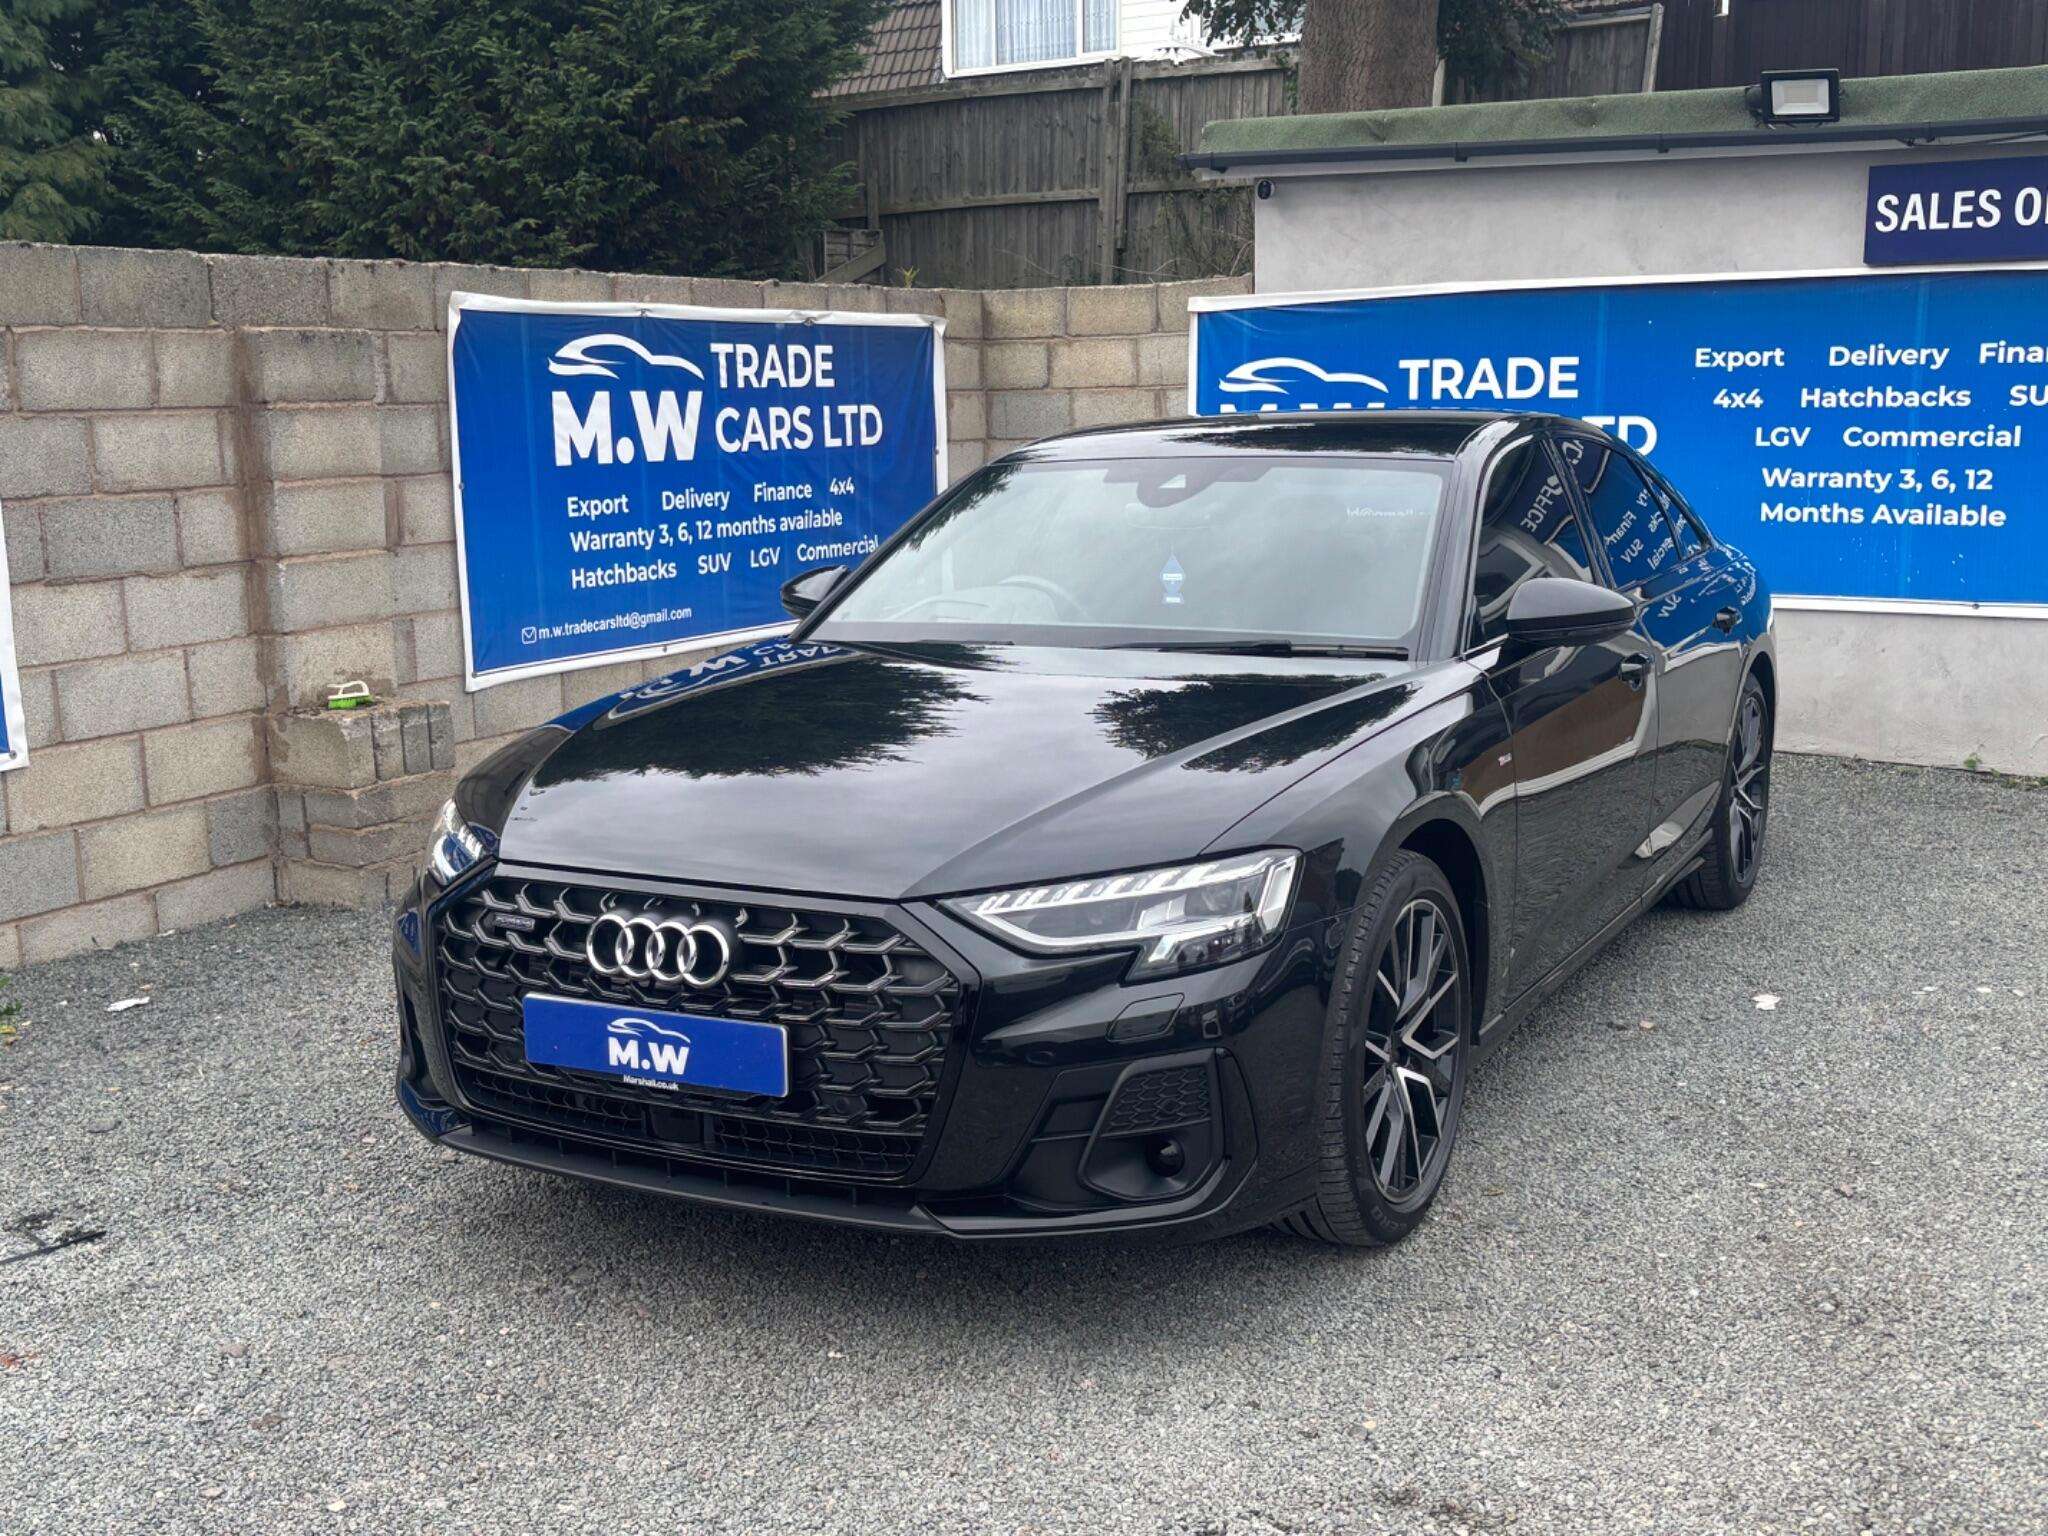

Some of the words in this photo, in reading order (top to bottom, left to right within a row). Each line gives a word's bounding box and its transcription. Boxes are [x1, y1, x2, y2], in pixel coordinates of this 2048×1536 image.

[1875, 188, 2002, 233] SALES
[2014, 187, 2048, 226] O
[710, 342, 835, 388] TRADE
[1695, 347, 1785, 372] Export
[1829, 343, 1950, 370] Delivery
[1979, 340, 2048, 364] Fina
[1398, 356, 1580, 400] TRADE
[1713, 388, 1764, 408] 4x4
[1800, 385, 1971, 408] Hatchbacks
[551, 390, 703, 467] M.W
[715, 405, 814, 453] CARS
[822, 404, 883, 448] LTD
[1755, 426, 1811, 447] LGV
[1842, 424, 2022, 447] Commercial
[567, 494, 629, 521] Export
[661, 487, 730, 511] Delivery
[753, 481, 813, 503] Finance
[829, 477, 855, 496] 4x4
[1762, 467, 1892, 493] Warranty
[1898, 468, 1923, 493] 3,
[1931, 468, 1956, 494] 6,
[1965, 469, 1993, 490] 12
[569, 526, 655, 551] Warranty
[658, 523, 674, 547] 3,
[677, 521, 693, 545] 6,
[695, 520, 713, 540] 12
[716, 514, 777, 538] months
[779, 508, 843, 532] available
[1760, 502, 1865, 524] Months
[1871, 503, 2007, 527] Available
[571, 558, 677, 590] Hatchbacks
[697, 552, 731, 575] SUV
[750, 546, 781, 568] LGV
[796, 535, 879, 562] Commercial
[538, 607, 692, 639] m.w.tradecarsltd@gmail.com
[607, 1036, 690, 1075] M.W
